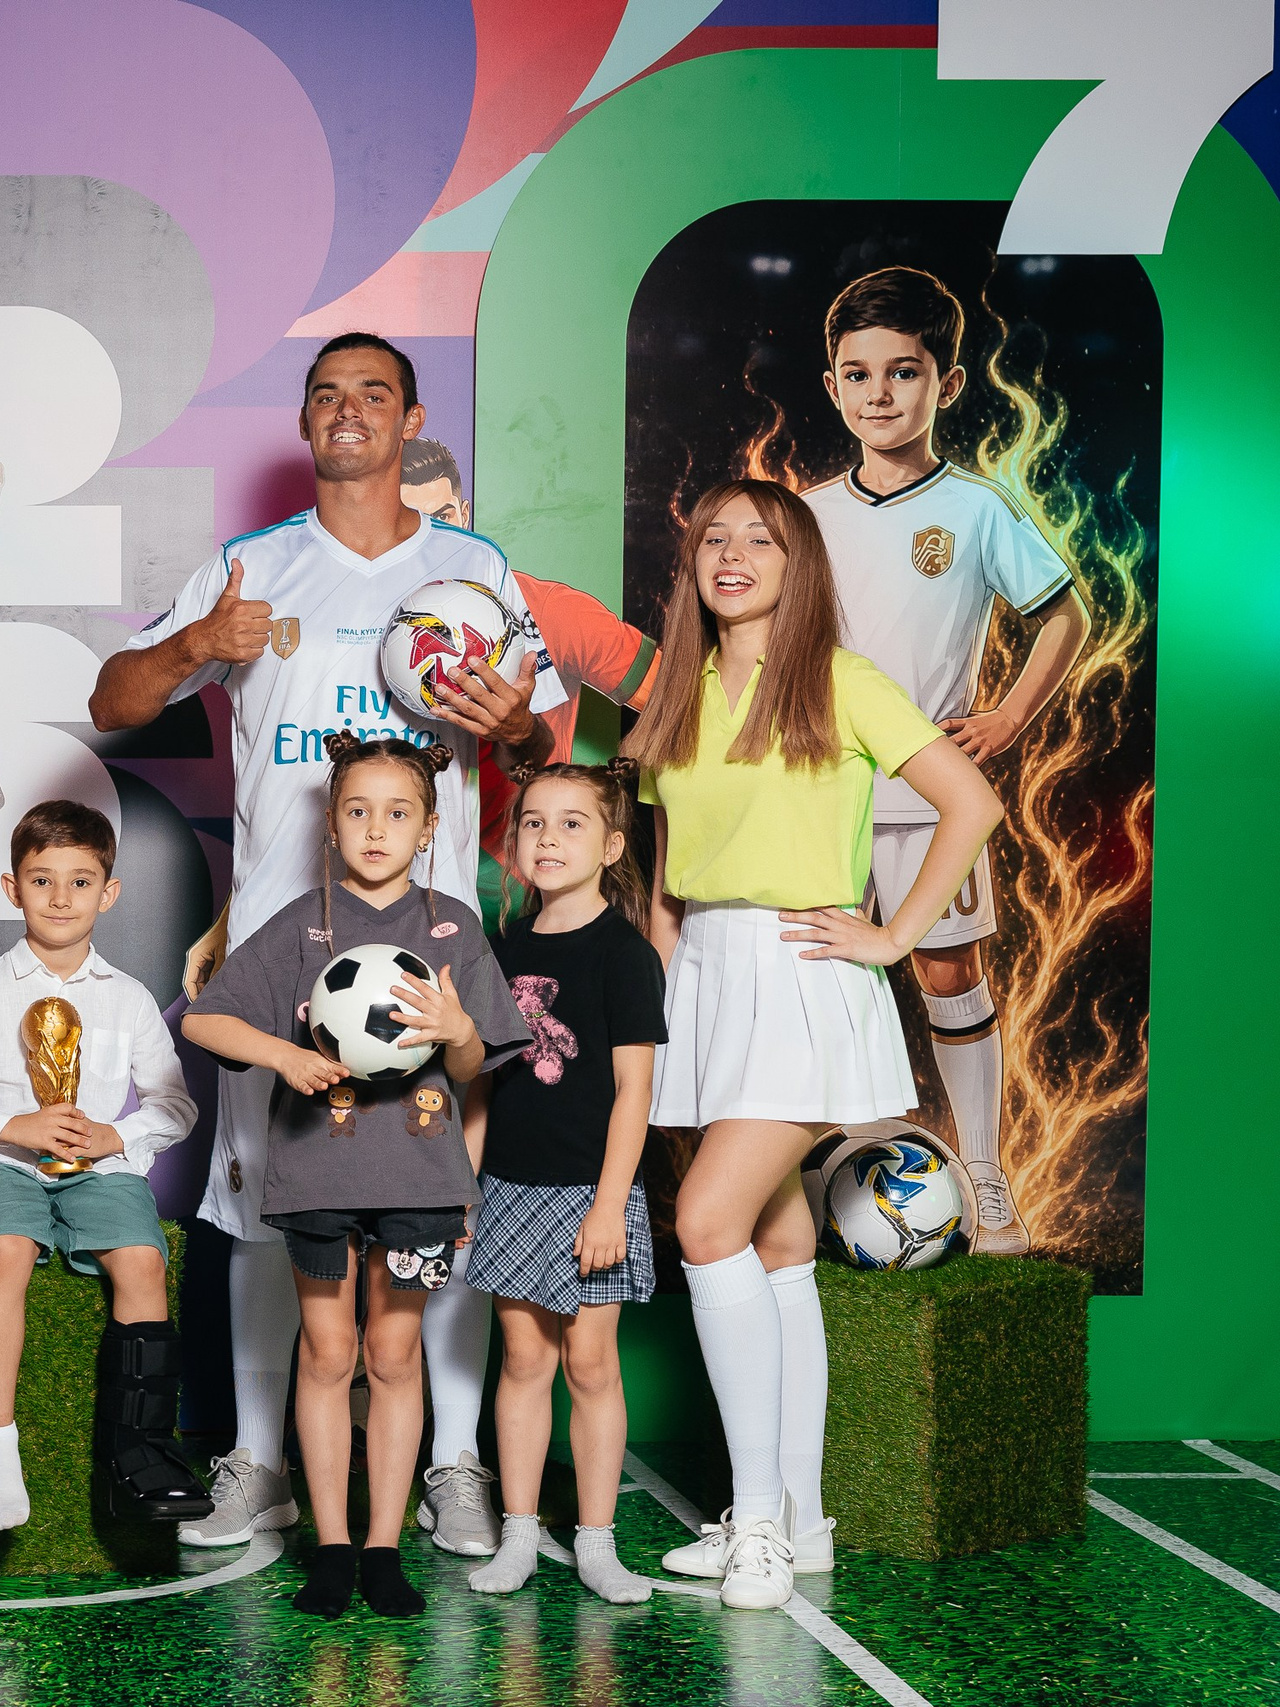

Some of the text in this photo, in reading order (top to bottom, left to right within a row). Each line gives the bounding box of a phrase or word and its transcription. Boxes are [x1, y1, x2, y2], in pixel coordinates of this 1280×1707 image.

[936, 0, 1276, 255] 7
[336, 627, 359, 636] FINAL
[360, 628, 377, 636] KYIV
[336, 685, 393, 720] Fly
